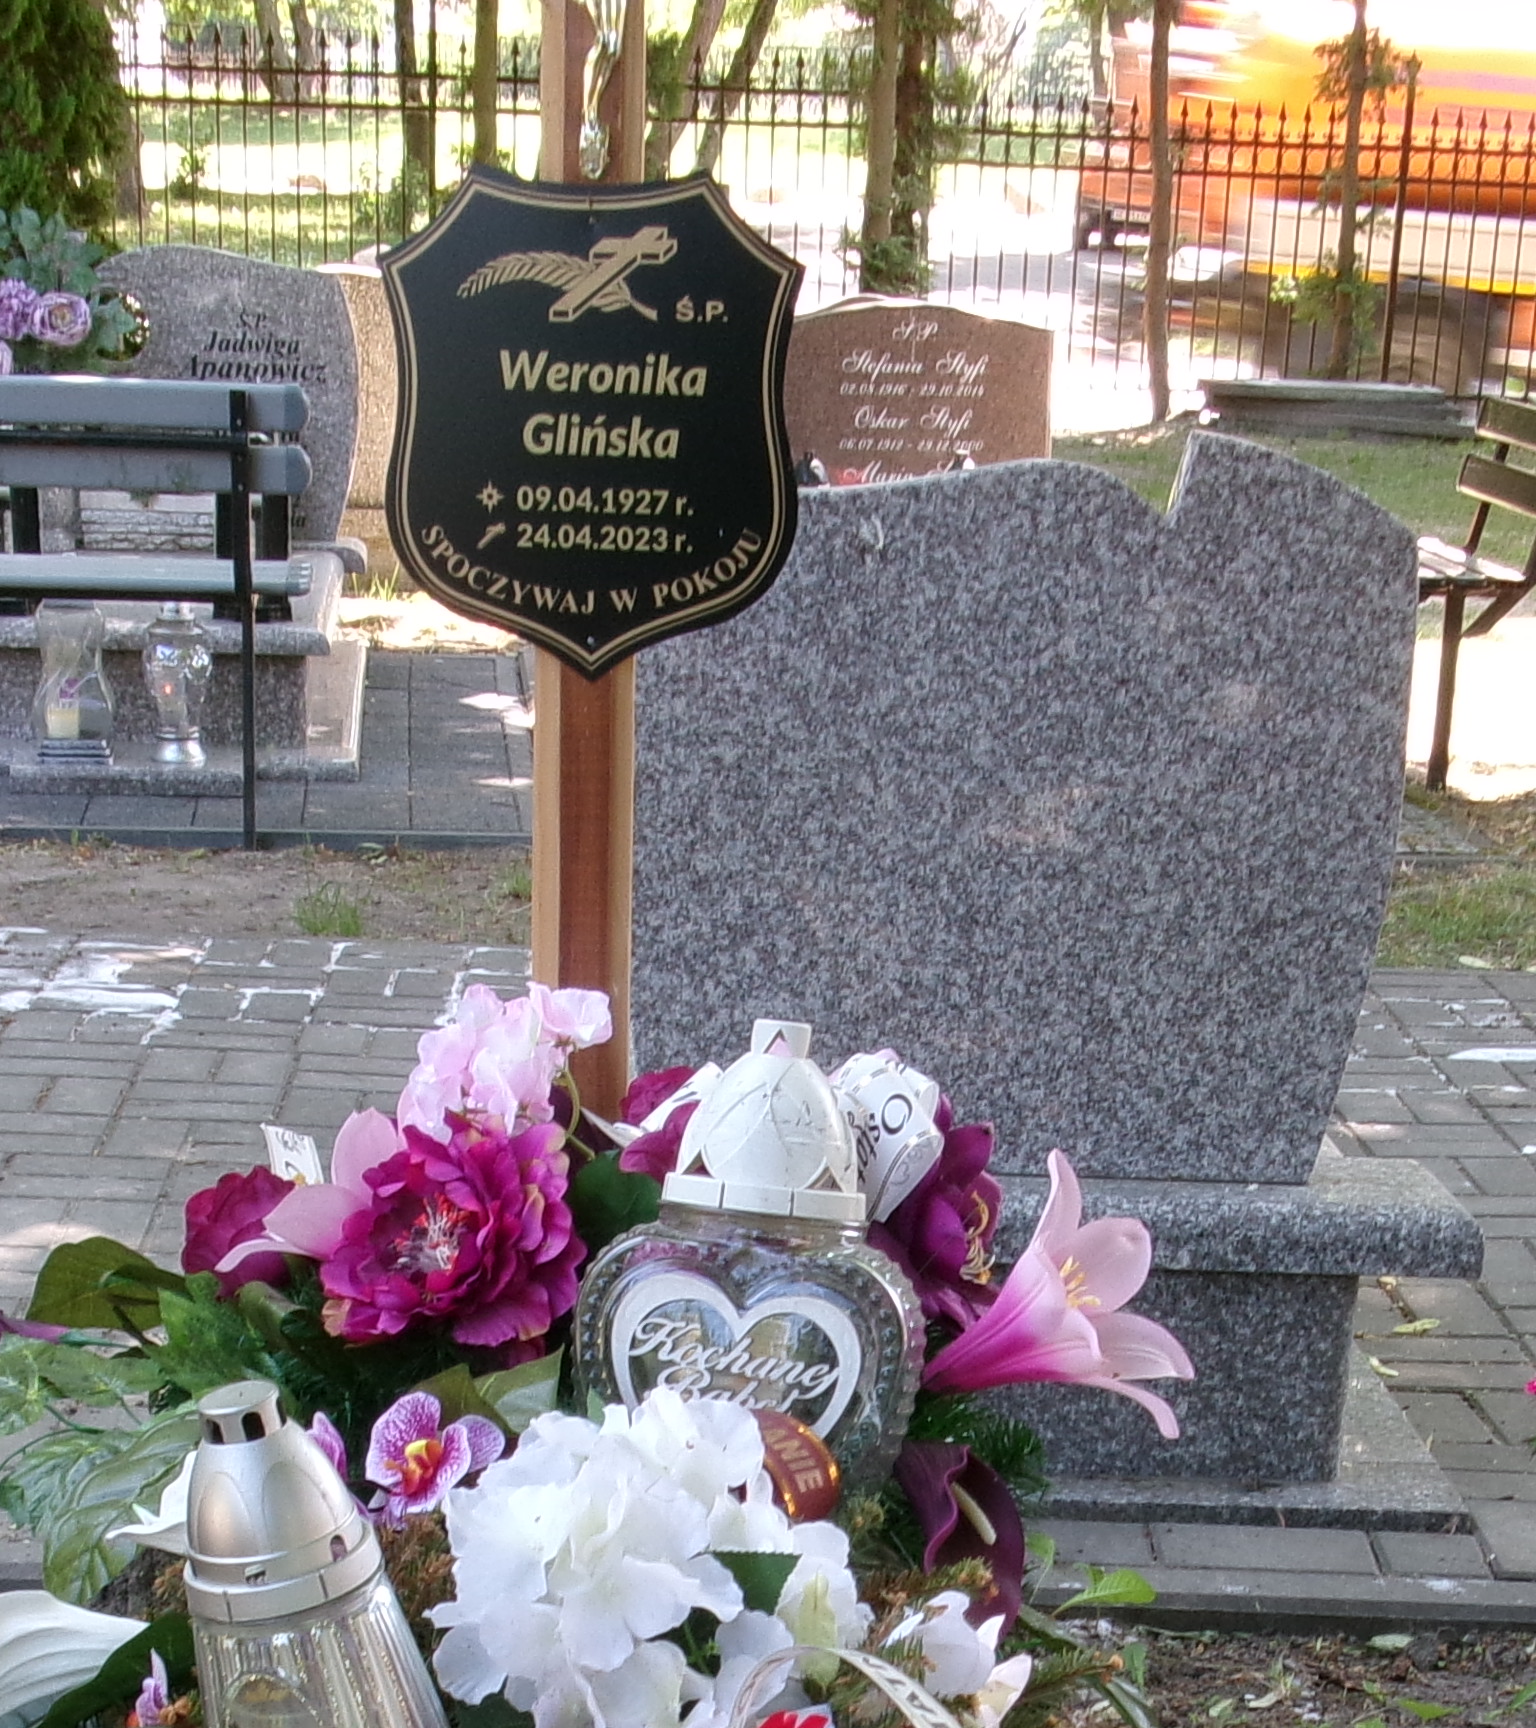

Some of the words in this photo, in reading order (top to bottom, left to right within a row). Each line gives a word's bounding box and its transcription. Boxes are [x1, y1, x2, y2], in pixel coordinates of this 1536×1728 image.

[675, 294, 729, 322] Ś.P.
[204, 331, 301, 357] Jadwiga
[185, 354, 328, 382] Apanowicz
[499, 349, 708, 397] Weronika
[842, 350, 924, 382] Stefania
[936, 350, 989, 384] Styfi
[522, 412, 680, 459] Glińska
[854, 404, 910, 430] Oskar
[920, 404, 973, 439] Styfi
[516, 485, 669, 516] 09.04.1927
[674, 495, 695, 517] r.
[516, 523, 669, 551] 24.04.2023
[674, 533, 694, 554] r.
[421, 524, 596, 615] SPOCZYWAJ
[609, 587, 638, 614] W
[652, 526, 763, 608] POKOJU
